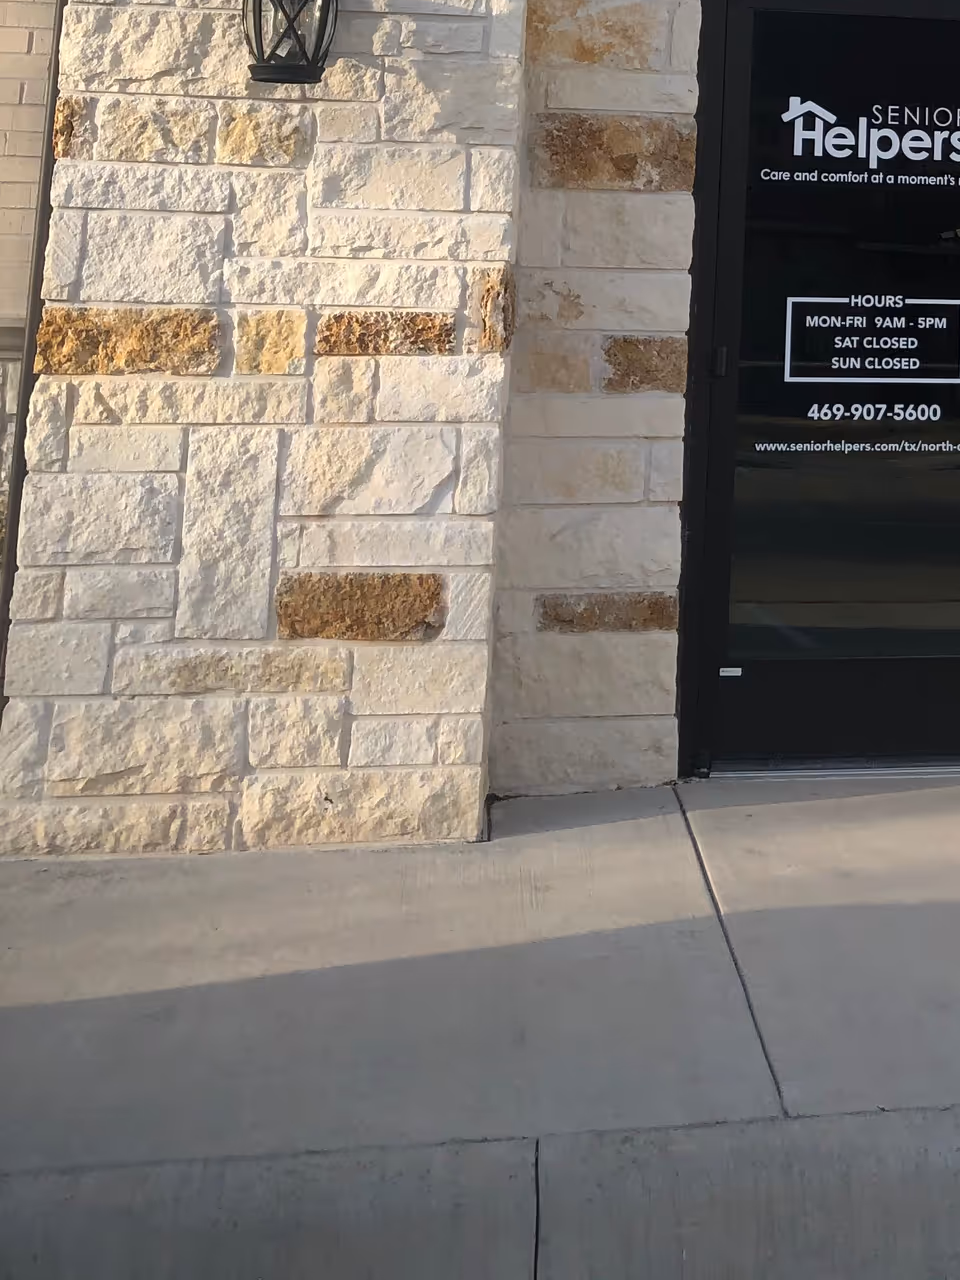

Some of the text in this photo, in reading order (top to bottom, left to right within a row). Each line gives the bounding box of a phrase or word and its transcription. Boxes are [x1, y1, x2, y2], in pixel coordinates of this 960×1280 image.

[760, 168, 791, 181] Care
[793, 170, 818, 182] and
[821, 170, 868, 183] comfort
[871, 172, 884, 184] at
[886, 174, 895, 184] a
[897, 173, 955, 186] moment's
[850, 295, 904, 308] HOURS
[805, 315, 866, 328] MON-FRI
[874, 316, 905, 328] 9AM
[917, 317, 947, 329] 5PM
[834, 336, 918, 349] SAT CLOSED
[831, 357, 920, 370] SUN CLOSED
[807, 403, 941, 421] 469-907-5600
